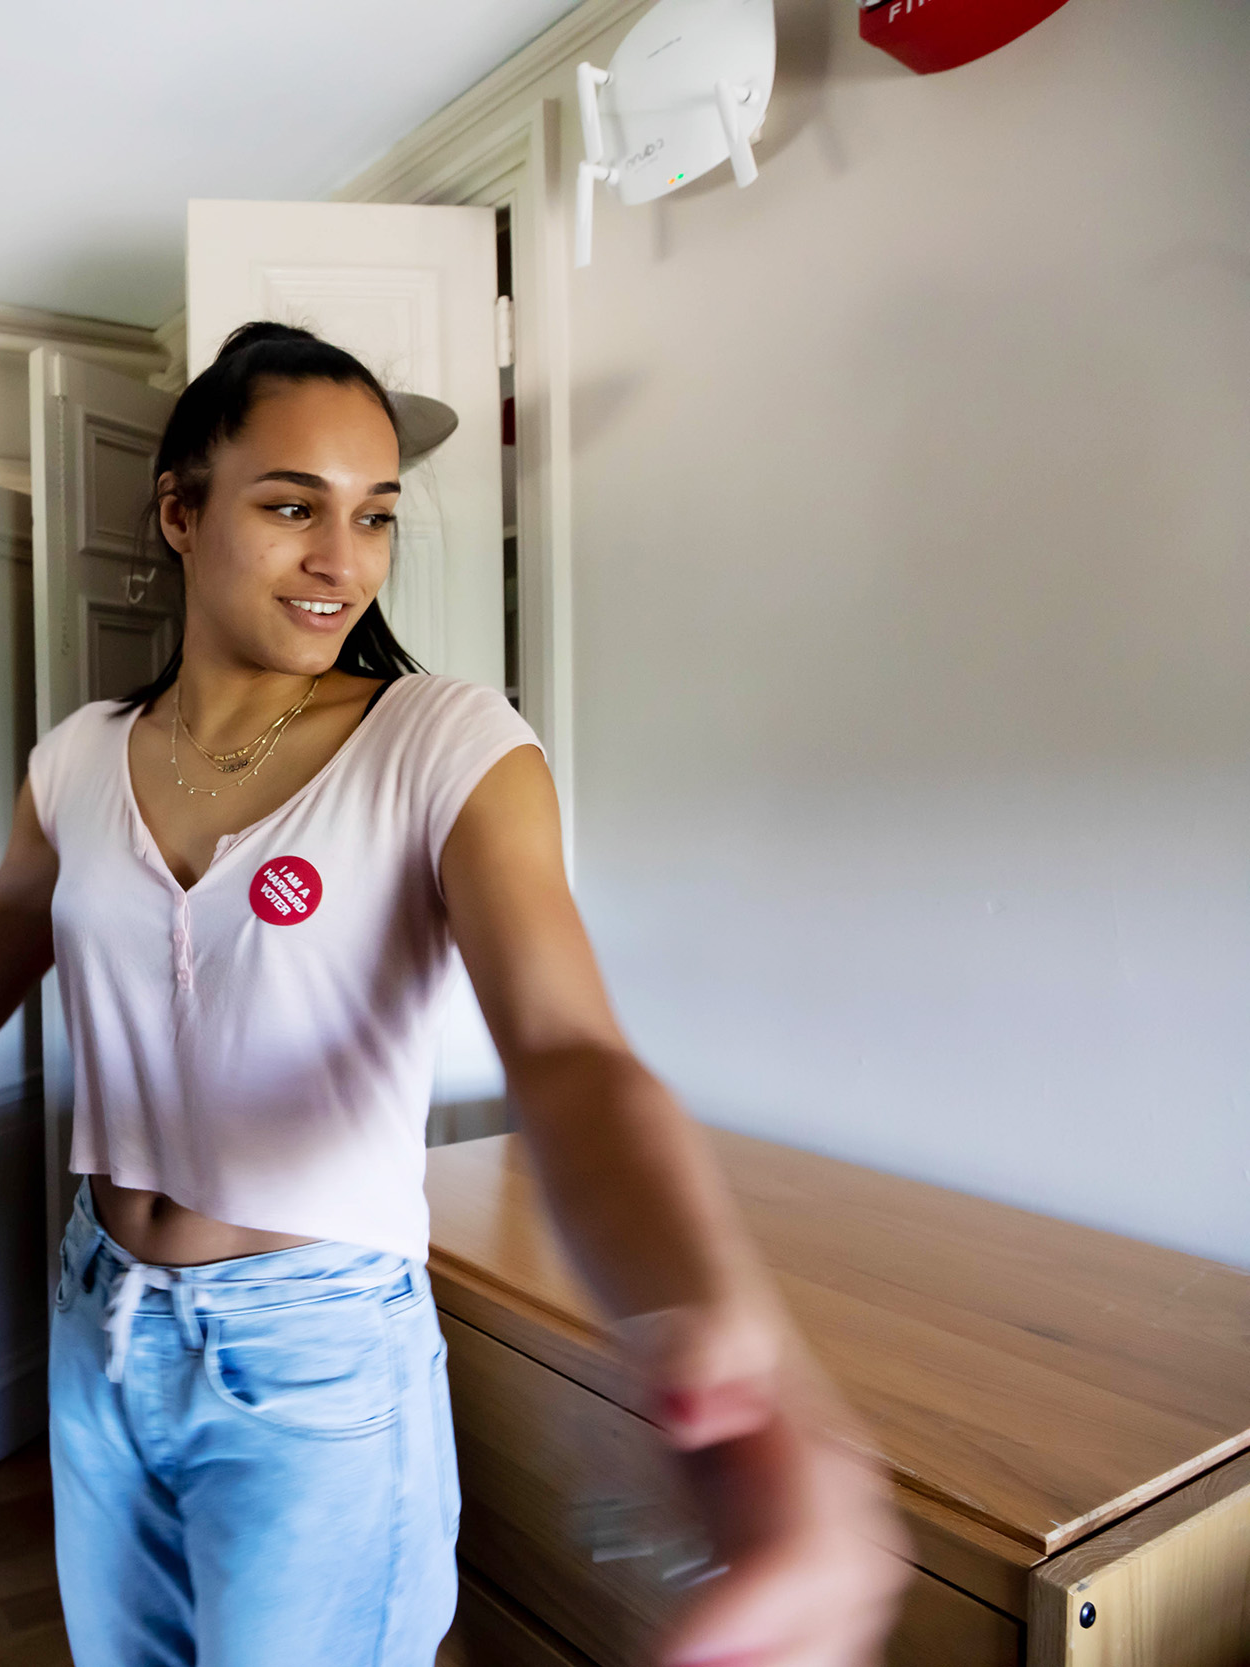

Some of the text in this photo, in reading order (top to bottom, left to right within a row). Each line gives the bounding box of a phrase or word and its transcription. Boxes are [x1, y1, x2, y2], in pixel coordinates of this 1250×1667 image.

[263, 868, 308, 914] HARVARD
[279, 866, 310, 898] I AM A
[260, 883, 292, 916] VOTER
